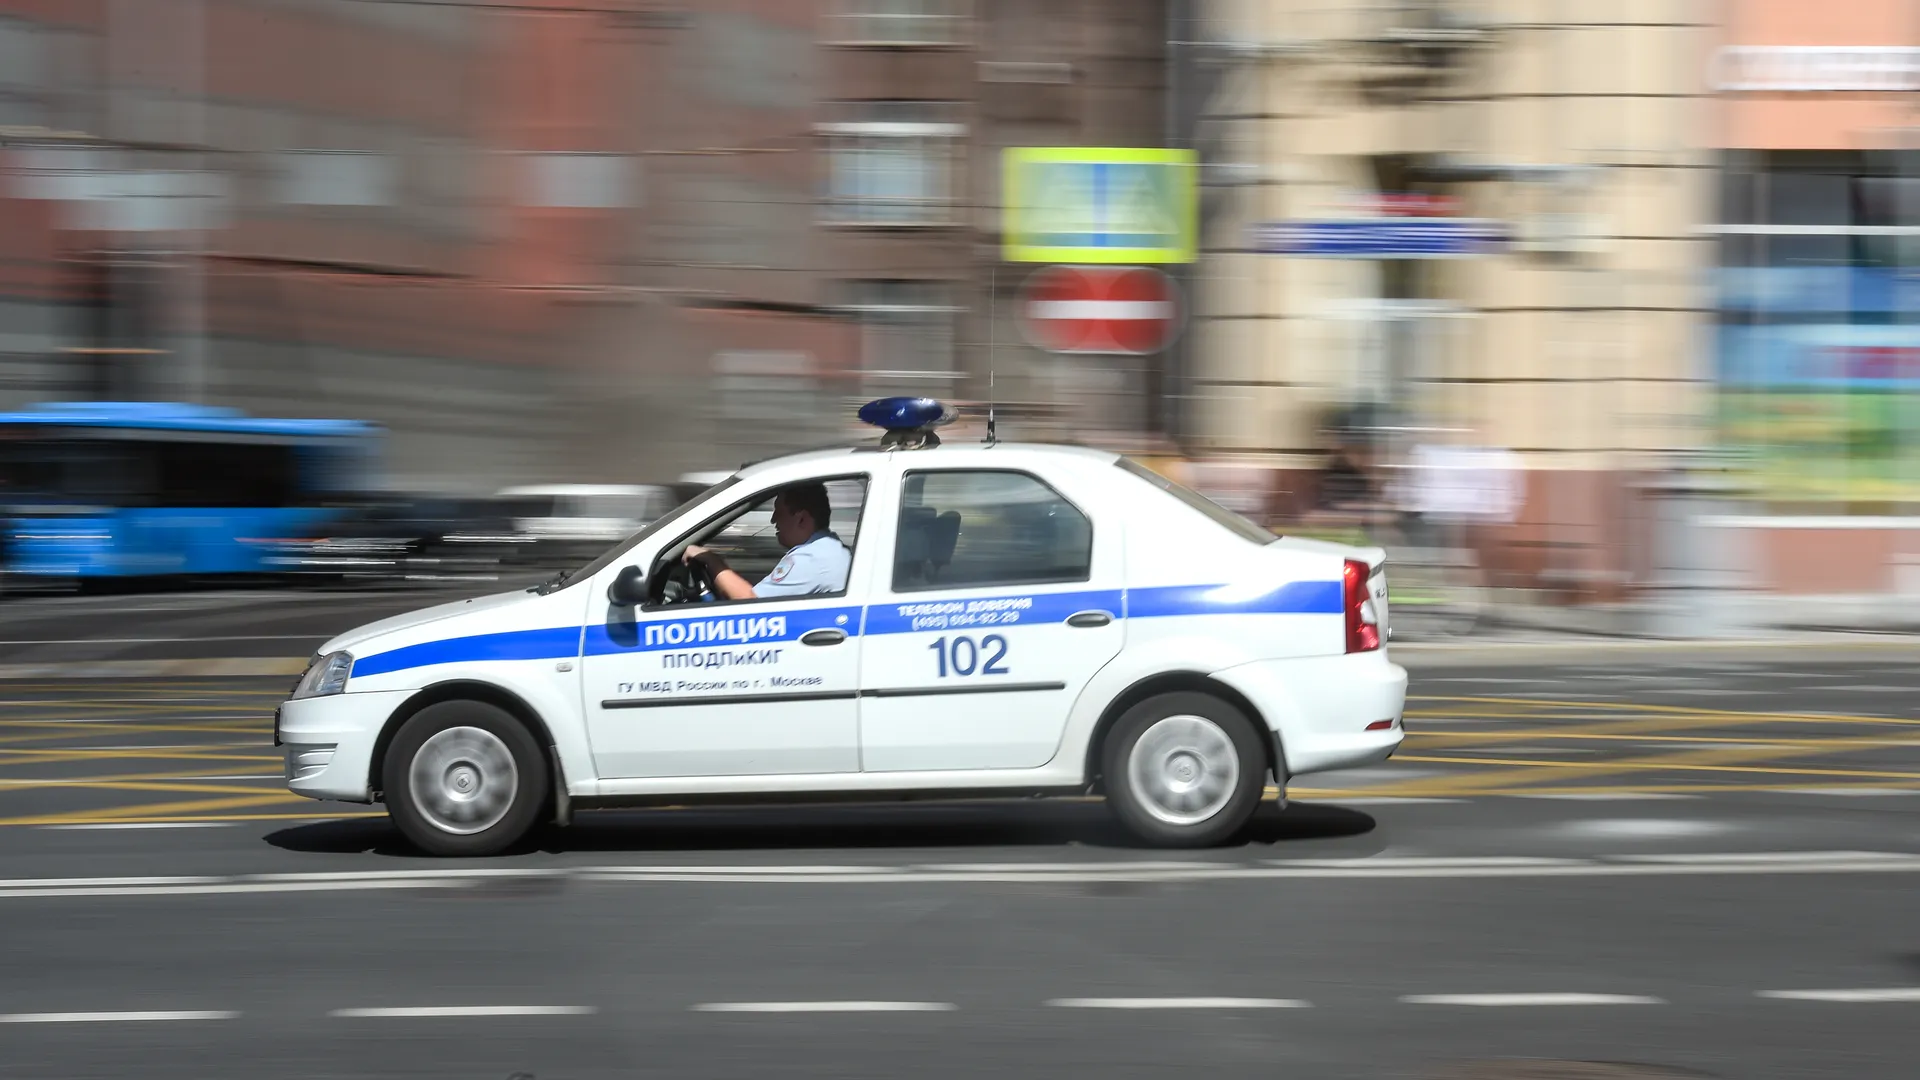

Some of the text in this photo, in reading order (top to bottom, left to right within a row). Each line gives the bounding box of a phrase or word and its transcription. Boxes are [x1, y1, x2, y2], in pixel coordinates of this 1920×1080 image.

[897, 597, 1033, 617] ТЕЛЕФОН ДОВЕРИЯ
[645, 616, 787, 646] ПОЛИЦИЯ
[912, 614, 949, 632] (495)
[928, 634, 1009, 678] 102
[617, 675, 823, 694] ГУ МВД России по г. Москве
